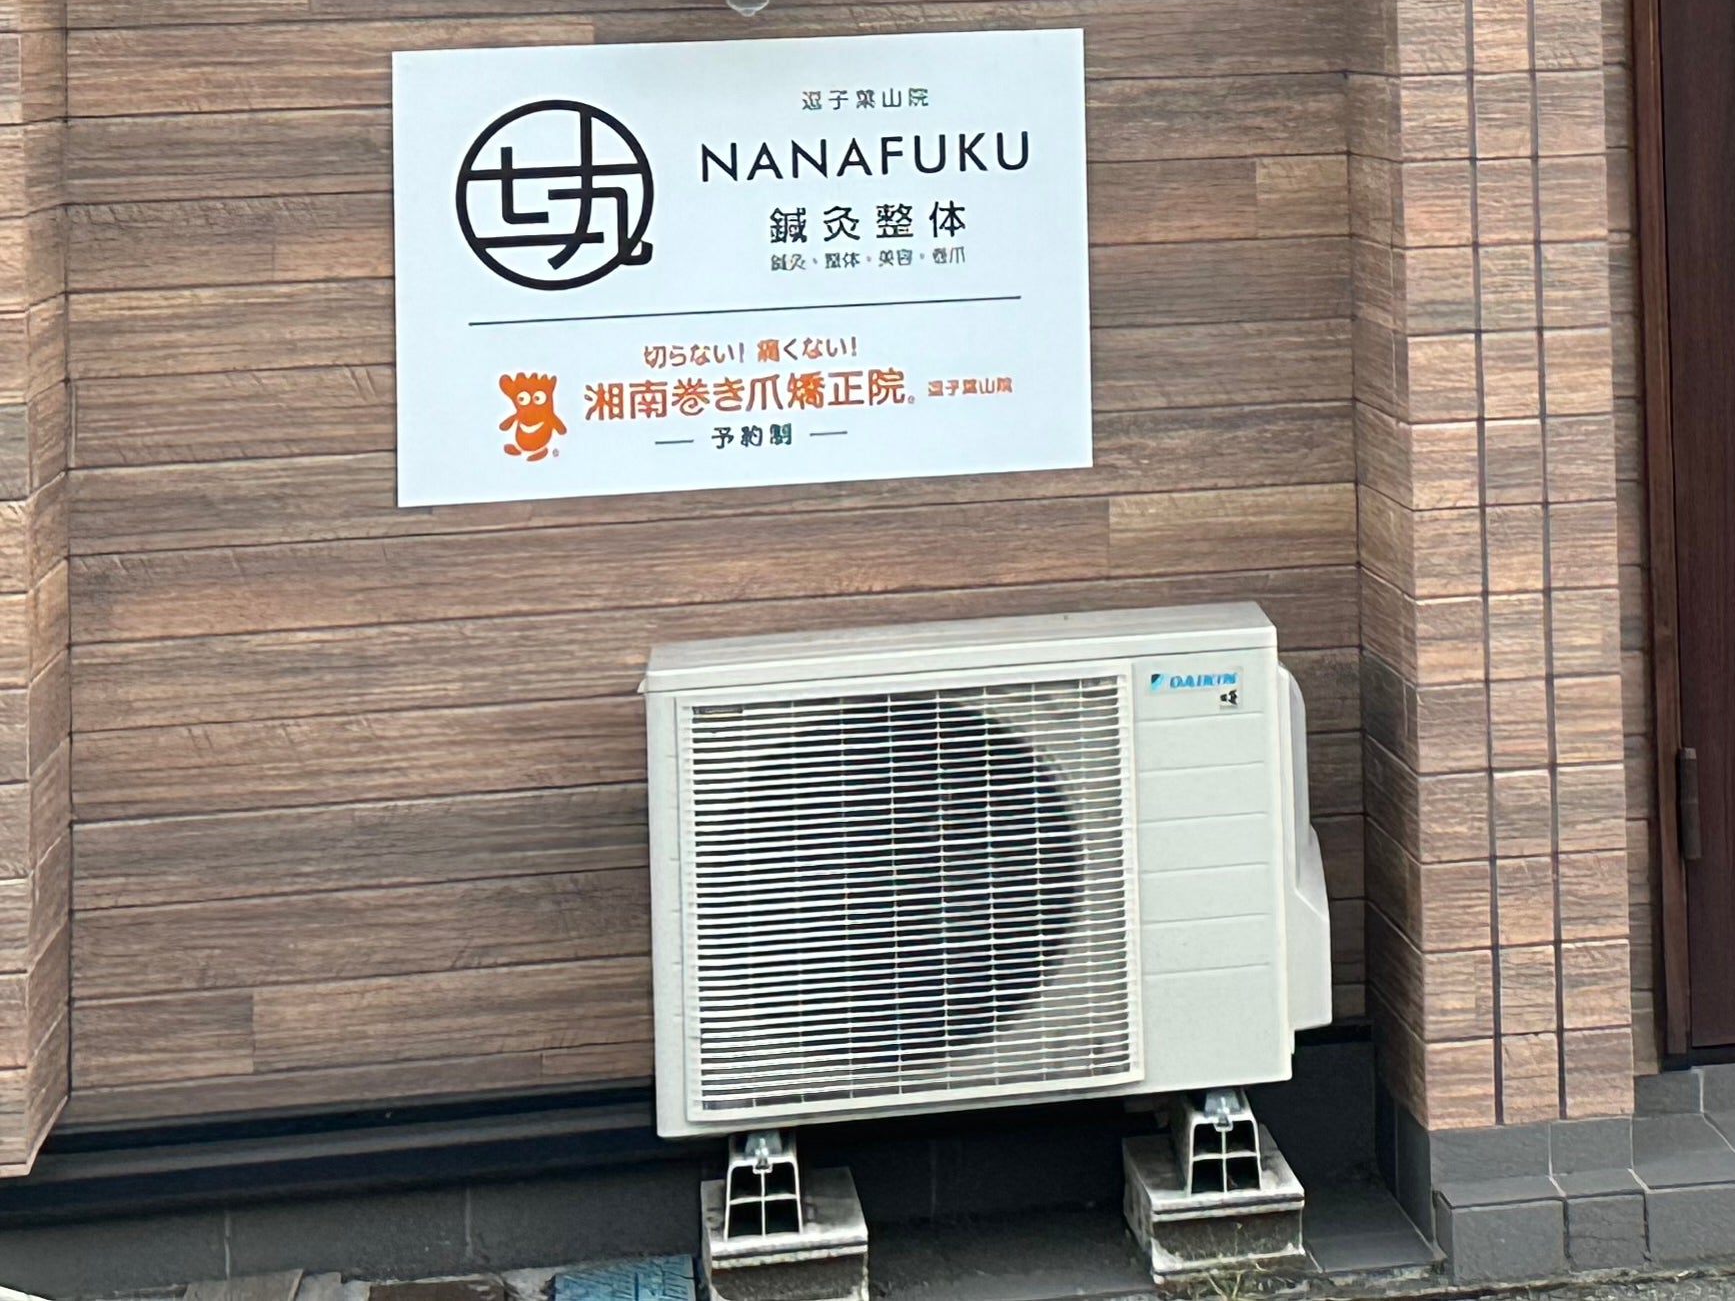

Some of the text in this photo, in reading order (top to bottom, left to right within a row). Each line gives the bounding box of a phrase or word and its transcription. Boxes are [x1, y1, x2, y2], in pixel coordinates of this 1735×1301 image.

[701, 130, 1029, 183] NANAFUKU
[769, 199, 967, 244] 鍼灸整体
[1169, 671, 1237, 689] DAIKIN
